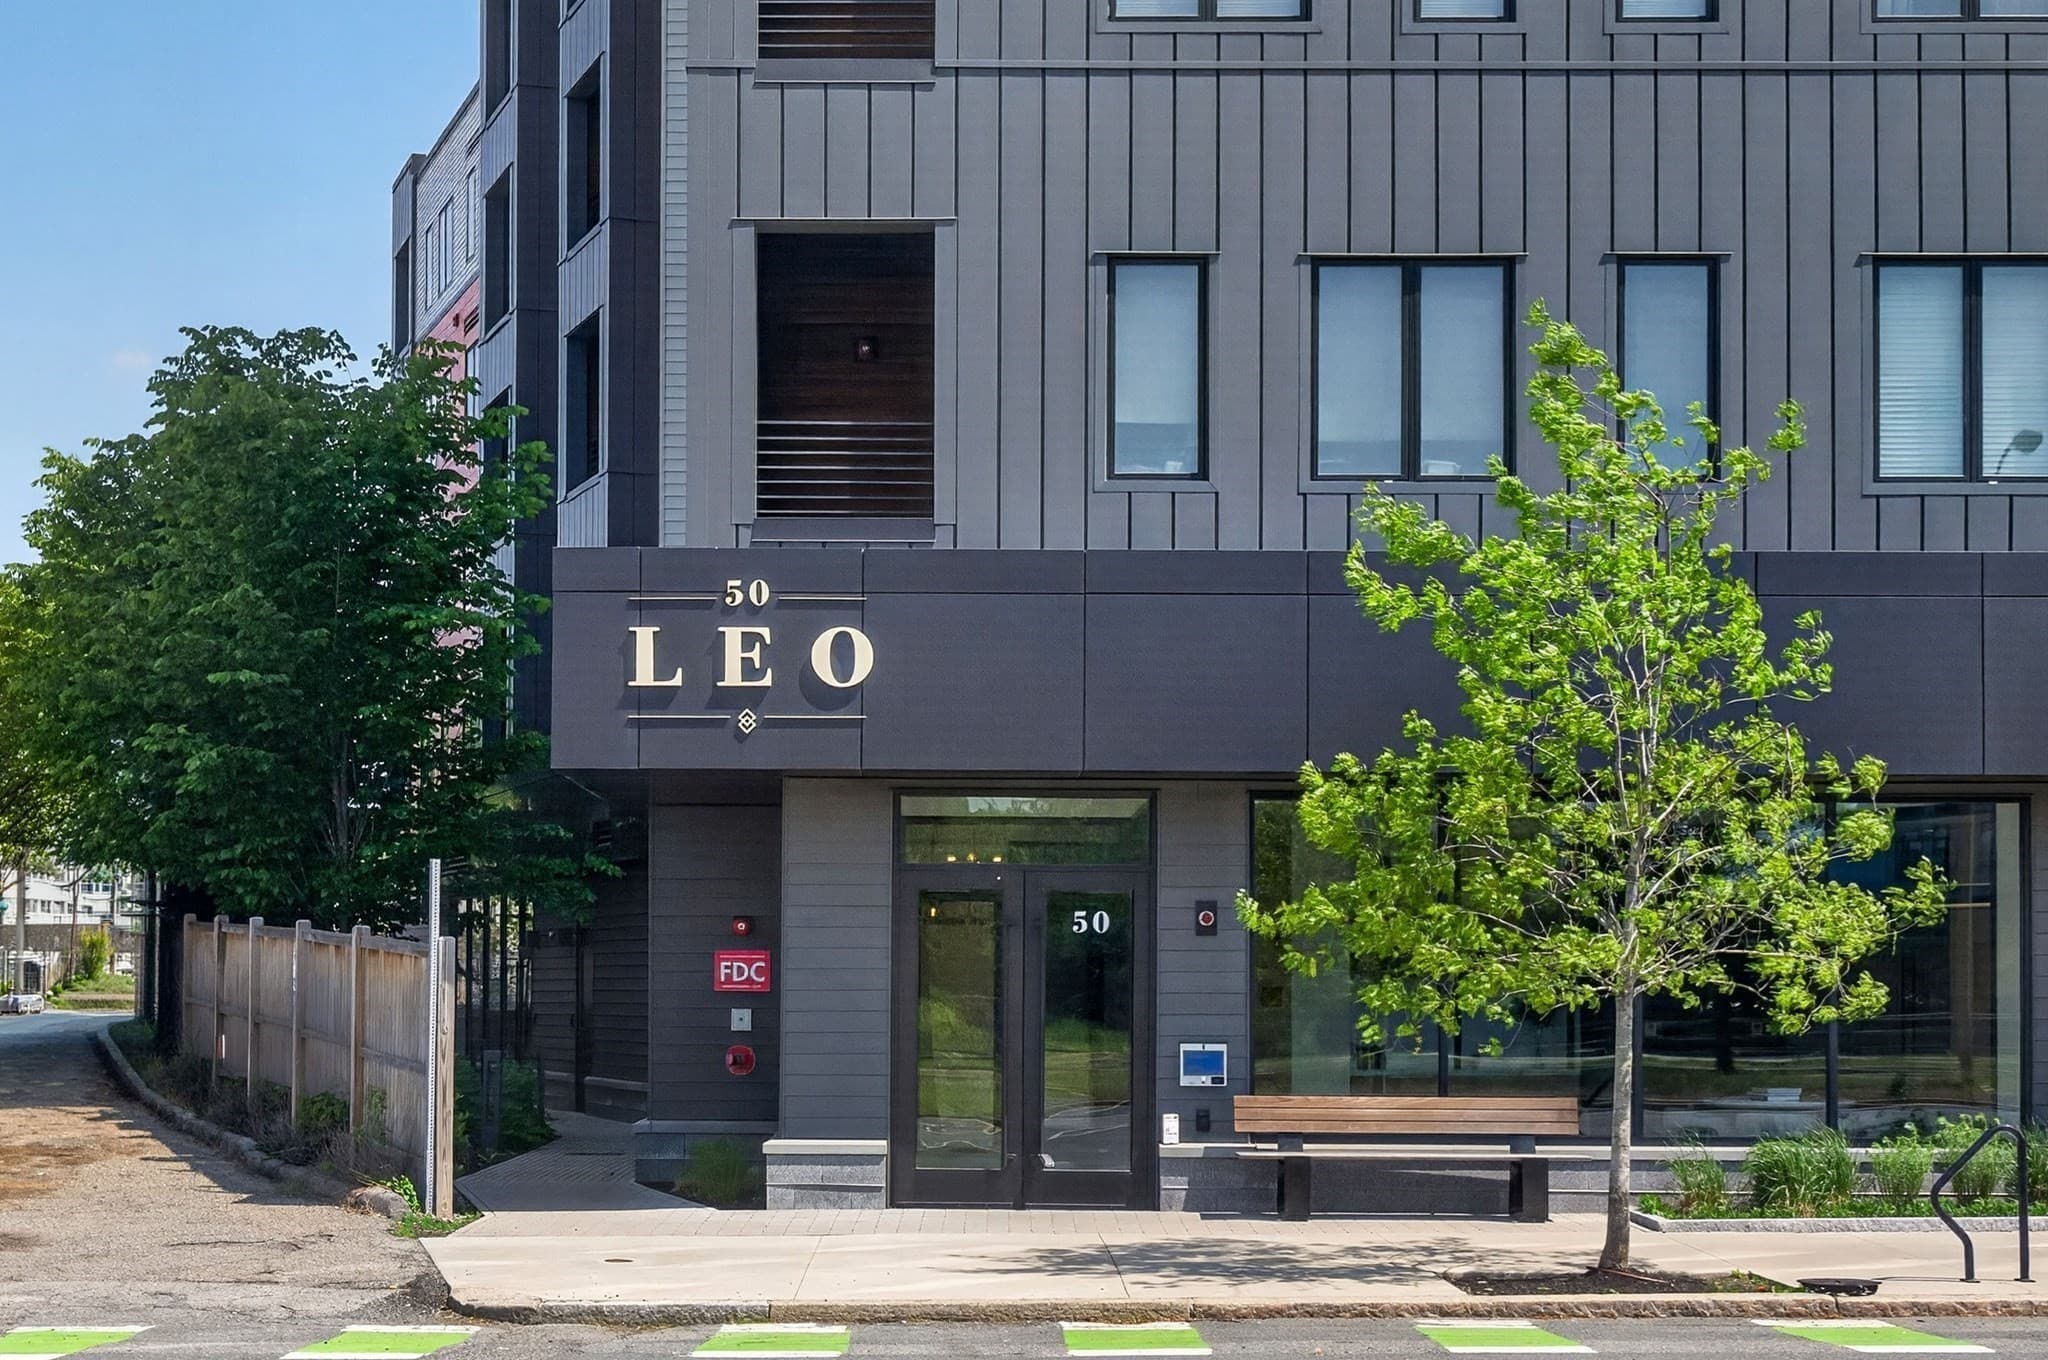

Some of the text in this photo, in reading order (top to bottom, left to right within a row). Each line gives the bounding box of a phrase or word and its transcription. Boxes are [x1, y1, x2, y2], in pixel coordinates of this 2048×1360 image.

[725, 579, 770, 607] 50
[627, 626, 874, 688] LEO
[1072, 910, 1110, 934] 50
[720, 962, 765, 982] FDC
